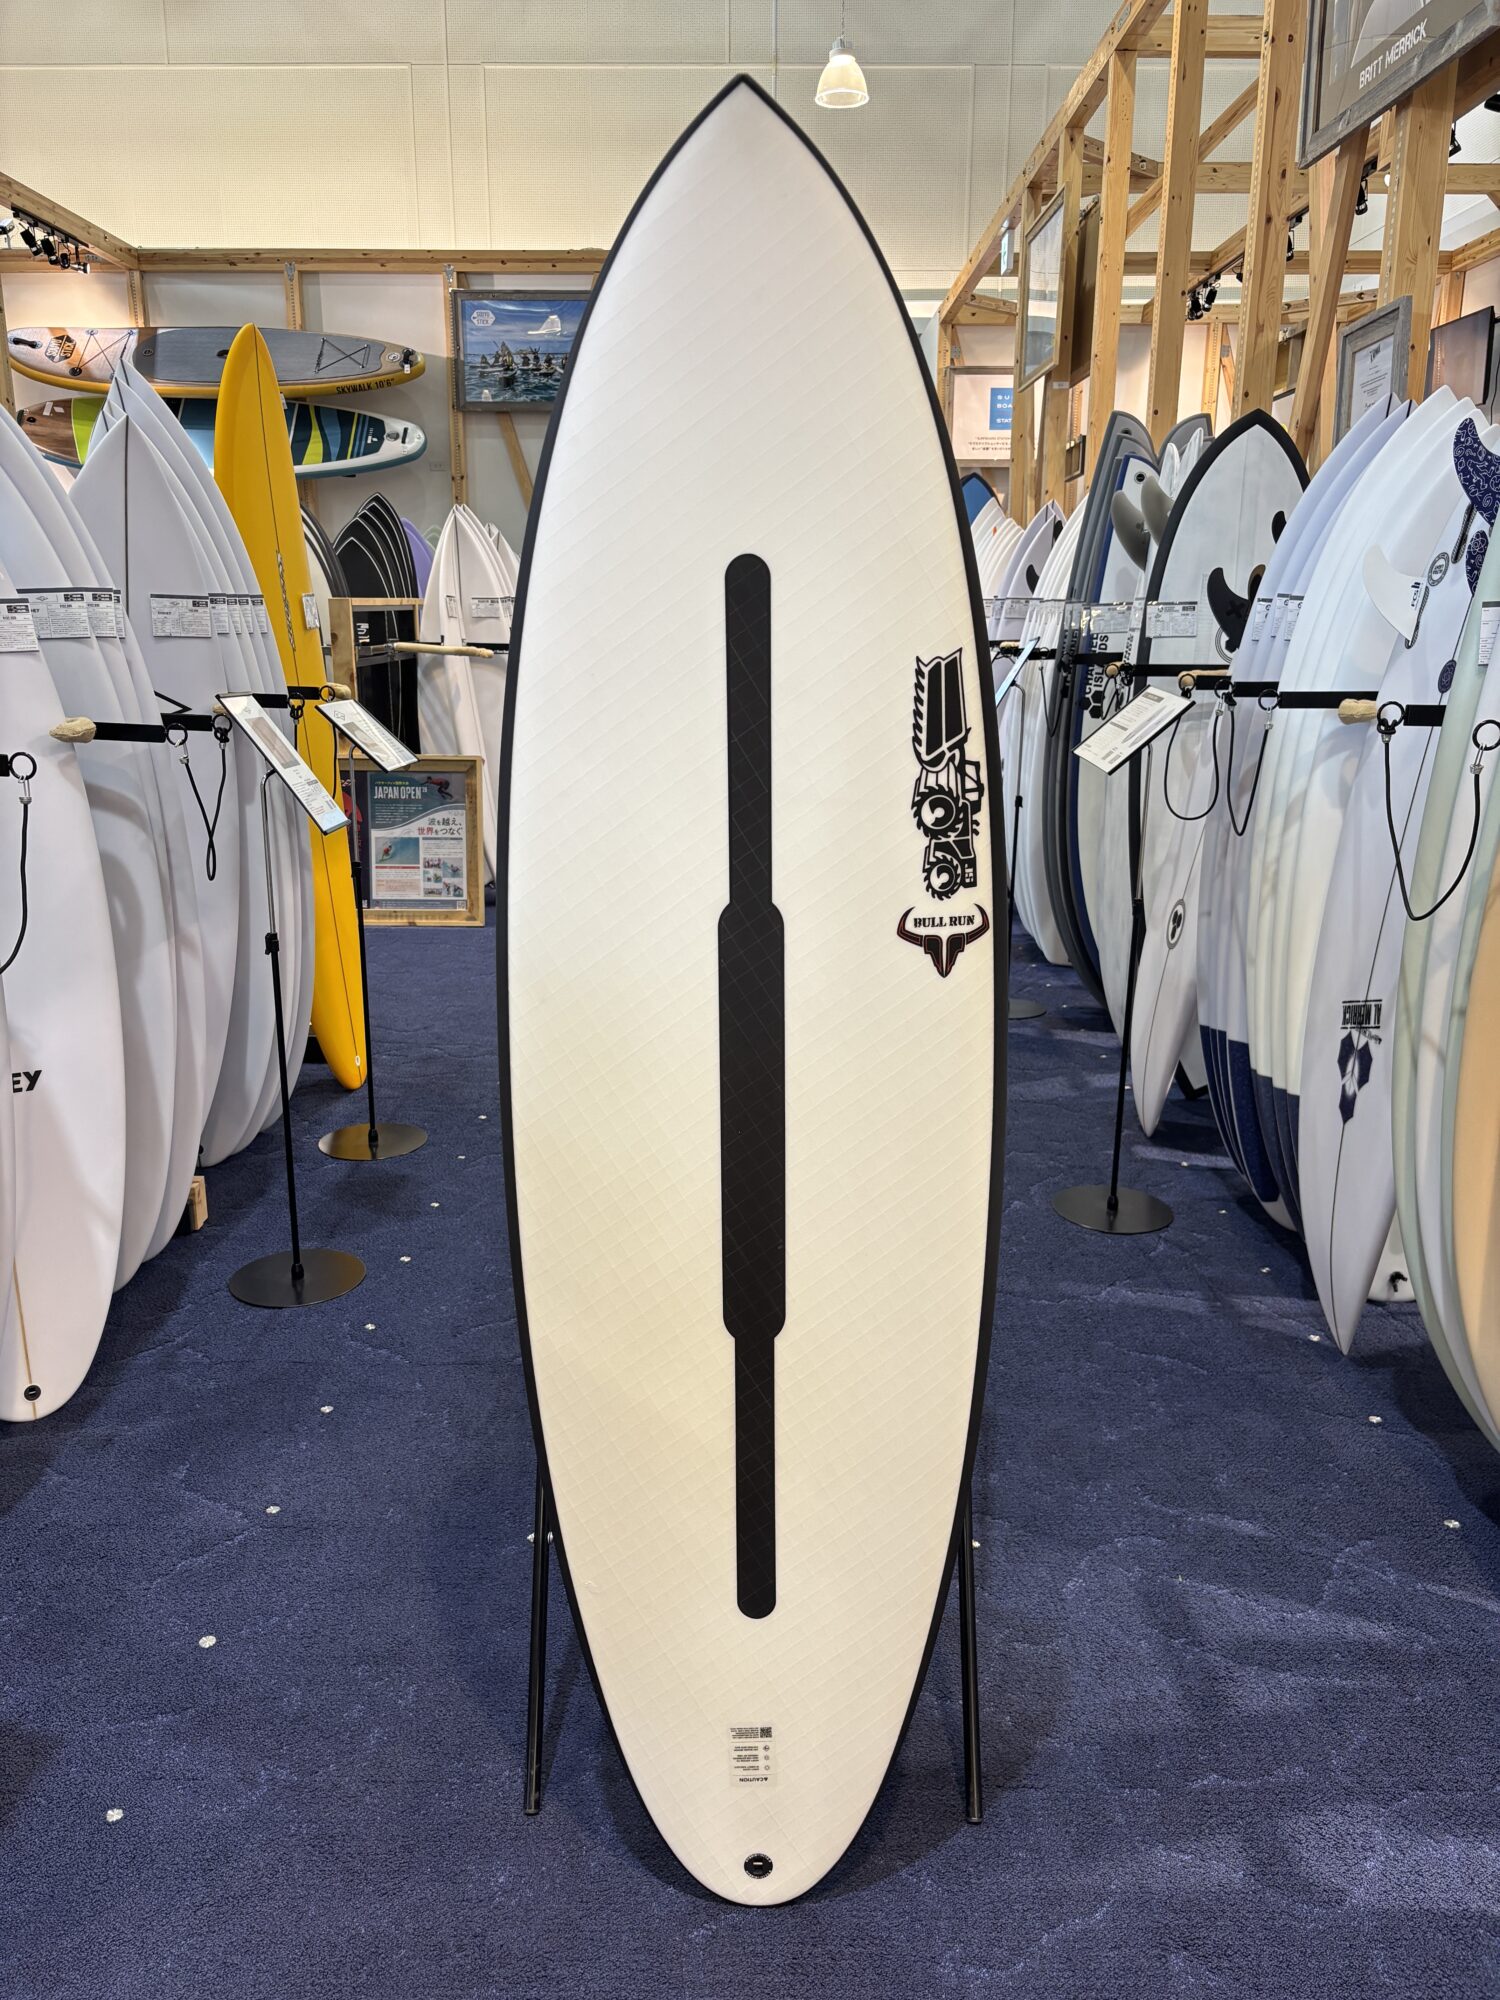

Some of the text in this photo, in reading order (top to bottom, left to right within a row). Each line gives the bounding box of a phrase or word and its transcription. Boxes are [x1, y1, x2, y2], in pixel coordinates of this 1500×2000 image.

[1359, 17, 1428, 90] BRITT MERRICK
[336, 378, 395, 395] SKYWALK 10'6"
[1093, 635, 1108, 688] ISLDS
[373, 786, 400, 800] JAPAN
[400, 786, 422, 800] OPEN
[428, 817, 463, 827] 波を越え、
[417, 826, 464, 836] 世界をつなぐ
[913, 914, 975, 928] BULL RUN
[1341, 1003, 1382, 1026] AL MERRICK
[11, 1069, 43, 1094] EY
